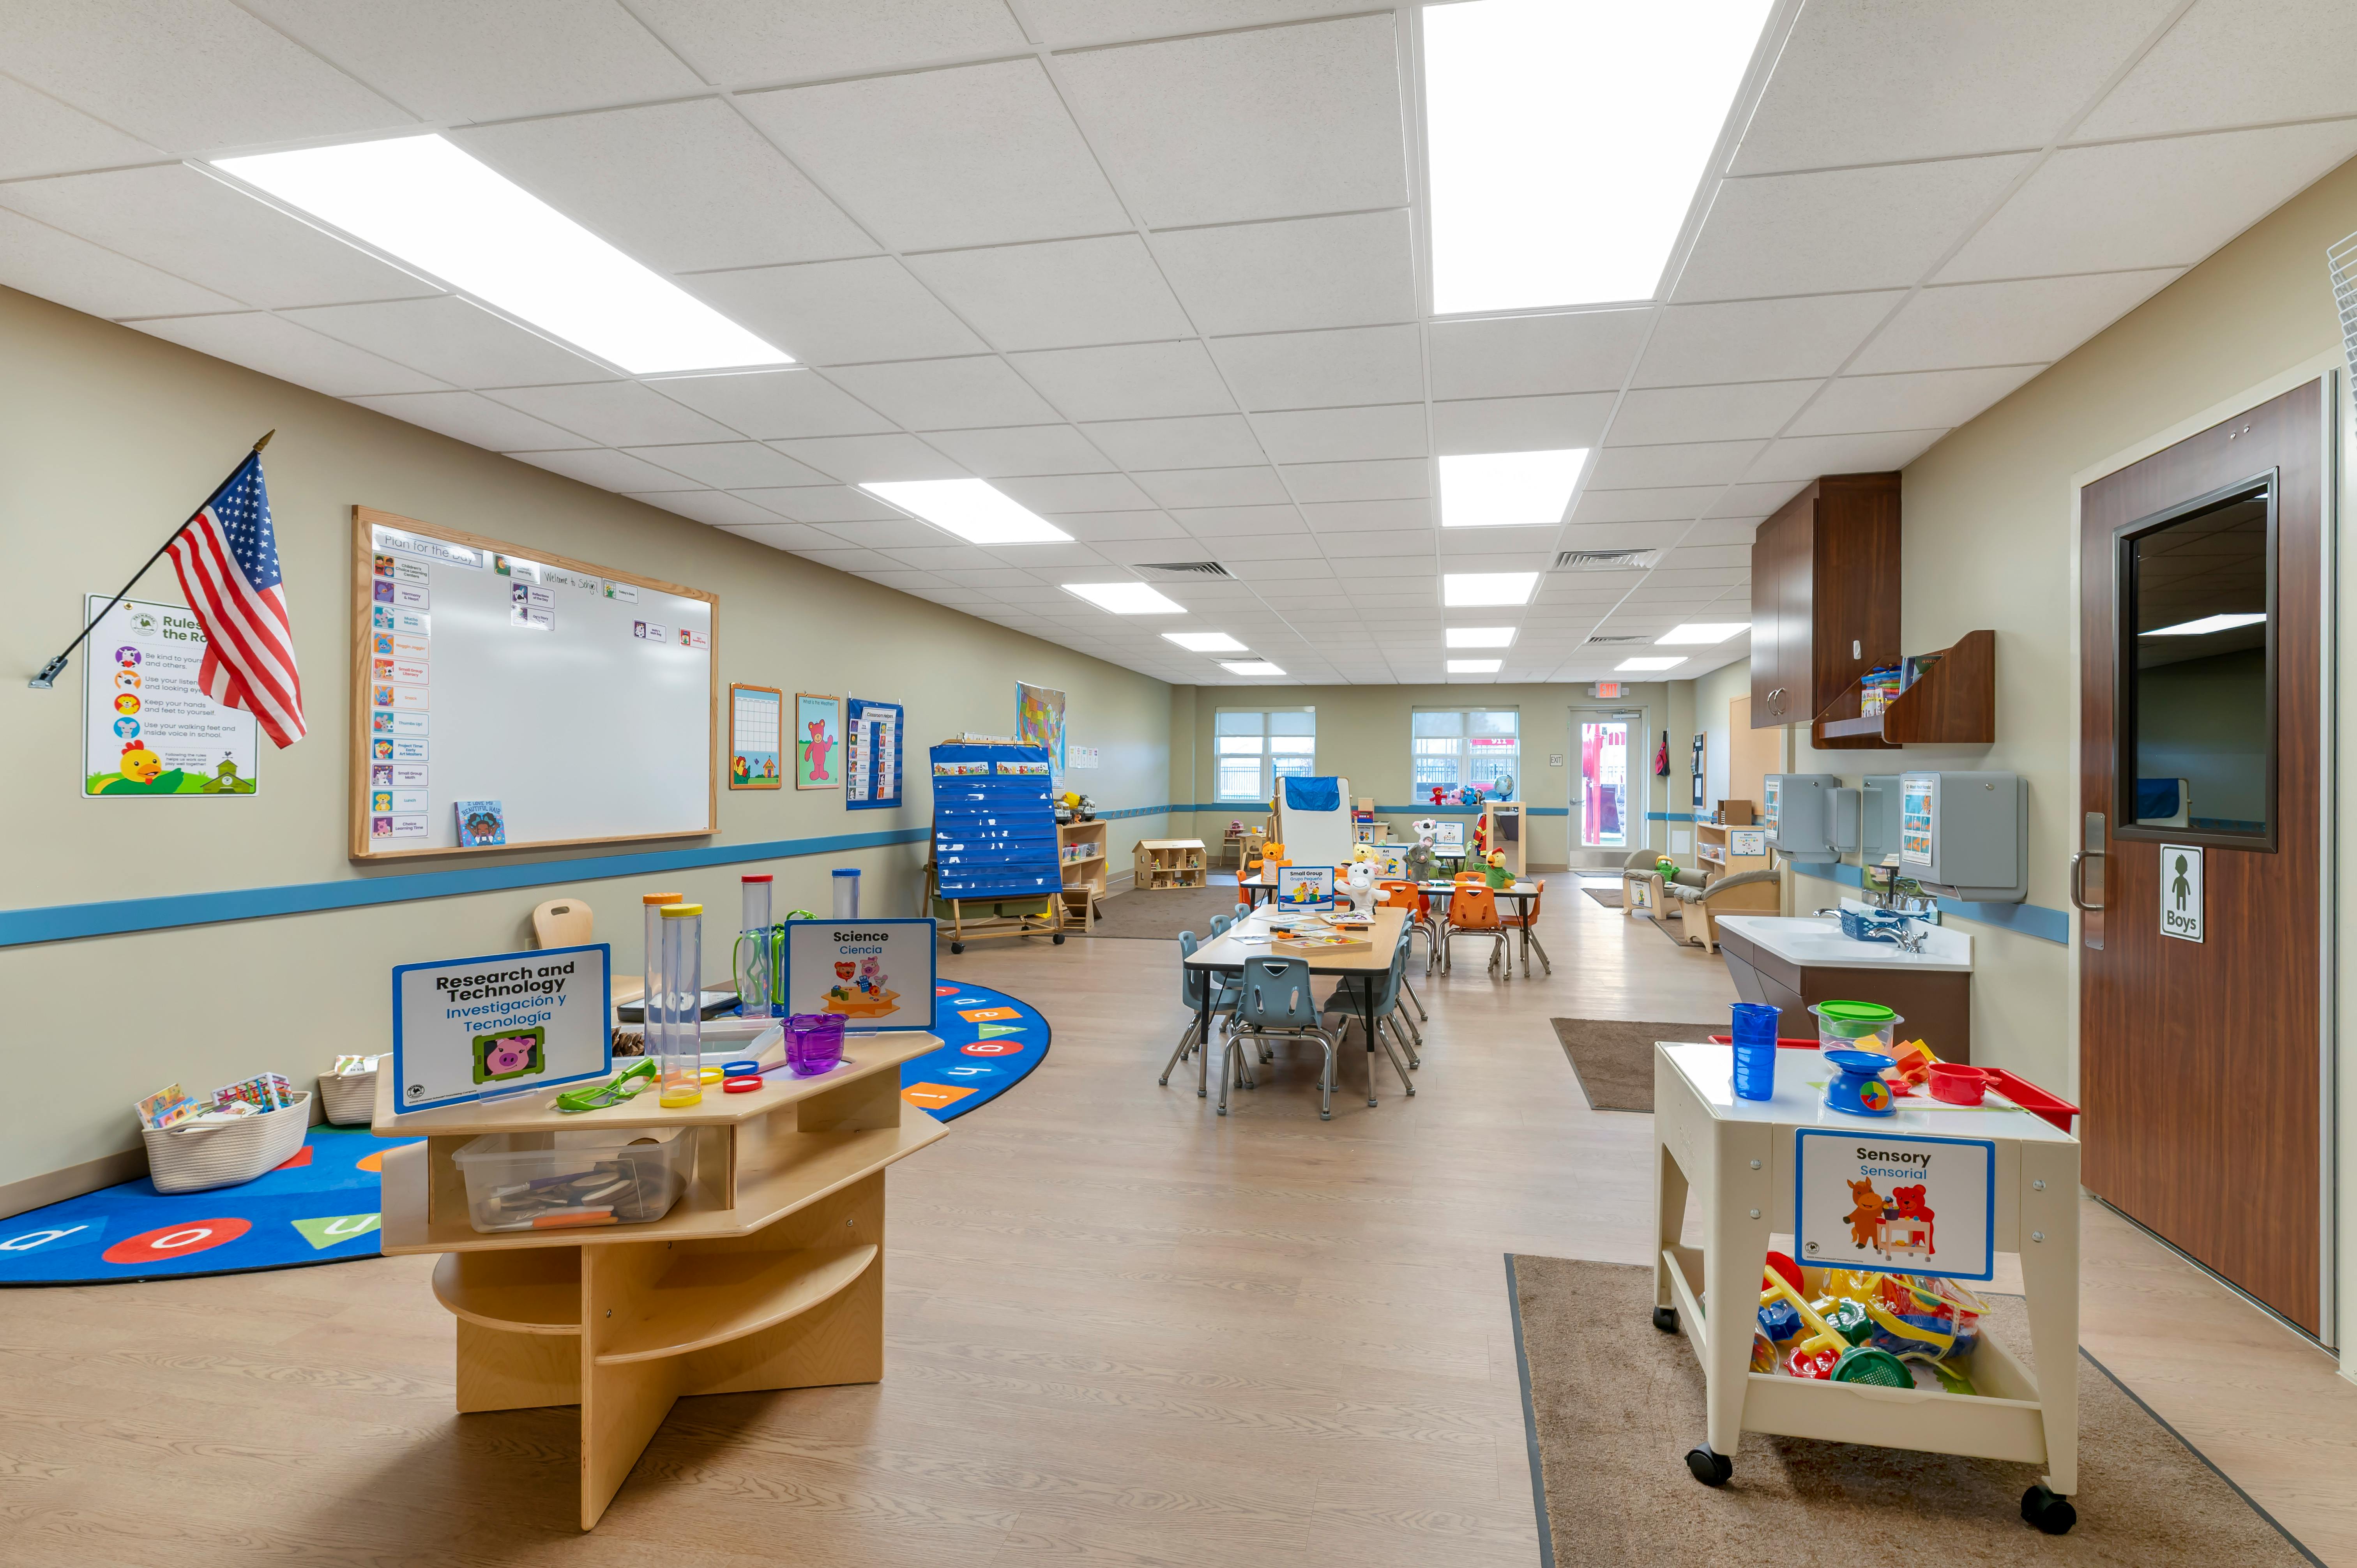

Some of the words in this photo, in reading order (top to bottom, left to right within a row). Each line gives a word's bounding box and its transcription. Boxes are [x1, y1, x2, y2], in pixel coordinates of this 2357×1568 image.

[385, 535, 409, 548] Plan
[413, 541, 428, 552] for
[432, 546, 449, 557] the
[544, 571, 567, 584] Welcome
[571, 577, 576, 586] to
[578, 579, 598, 593] School
[163, 616, 202, 630] Rules
[163, 629, 187, 640] the
[1600, 683, 1618, 697] EXIT
[461, 806, 488, 816] BEAUTIFUL
[489, 806, 500, 814] HAIR
[2167, 910, 2196, 932] Boys
[833, 931, 889, 942] Science
[839, 945, 882, 955] Ciencia
[436, 966, 533, 991] Research
[537, 961, 574, 977] and
[447, 977, 565, 1003] Technology
[447, 995, 553, 1019] Investigación
[558, 994, 566, 1006] y
[464, 1011, 551, 1032] Tecnología
[1856, 1147, 1931, 1168] Sensory
[1860, 1165, 1927, 1180] Sensorial
[151, 1228, 212, 1249] o
